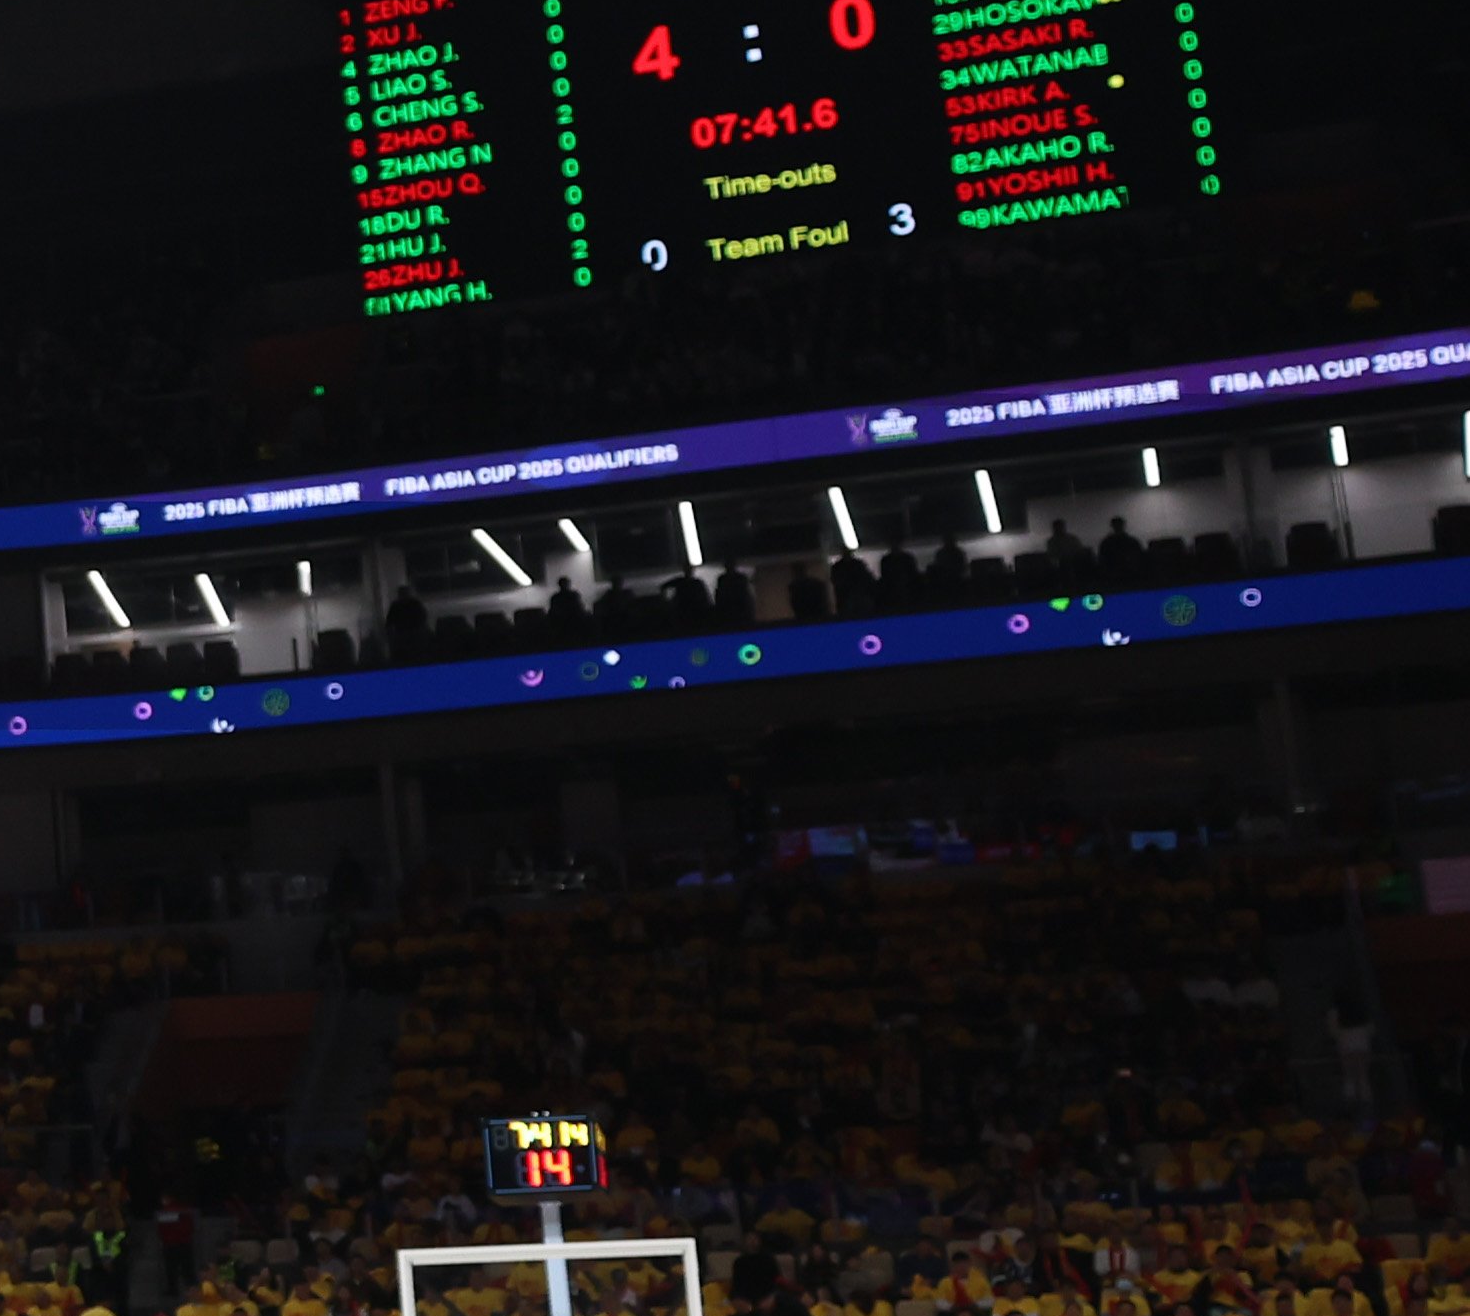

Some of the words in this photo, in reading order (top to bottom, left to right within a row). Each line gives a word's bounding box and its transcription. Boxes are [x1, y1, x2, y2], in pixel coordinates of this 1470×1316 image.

[340, 9, 352, 27] 1
[1067, 17, 1096, 39] R.
[340, 34, 356, 54] 2
[365, 24, 401, 48] XU
[405, 21, 423, 43] J.
[631, 24, 681, 81] 4
[340, 59, 357, 80] 4
[366, 43, 438, 76] ZHAO
[441, 41, 460, 64] J.
[343, 86, 361, 106] 5
[369, 72, 427, 102] LIAO
[429, 68, 453, 91] S.
[1044, 80, 1071, 102] A.
[345, 112, 363, 132] 6
[372, 94, 459, 127] CHENG
[461, 90, 485, 114] S.
[690, 97, 840, 150] 07:41.6
[1073, 103, 1099, 126] S.
[376, 123, 447, 155] ZHAO
[451, 120, 476, 142] R.
[555, 103, 574, 125] 2
[1087, 130, 1115, 155] R.
[350, 164, 369, 184] 9
[377, 146, 467, 180] ZHANG
[469, 142, 493, 166] N
[1084, 160, 1115, 183] H.
[457, 172, 486, 196] Q.
[701, 162, 838, 201] Time-outs
[425, 204, 450, 227] R.
[428, 232, 447, 254] J.
[705, 233, 786, 263] Team
[788, 219, 850, 251] Foul
[887, 201, 917, 236] 3
[571, 238, 589, 260] 2
[465, 279, 493, 302] H.
[1210, 369, 1264, 396] FIBA
[1266, 362, 1321, 389] ASIA
[1322, 355, 1371, 381] CUP
[1372, 347, 1429, 376] 2025
[945, 403, 995, 428] 2025
[997, 397, 1046, 422] FIBA
[385, 473, 431, 499] FIBA
[432, 467, 476, 492] ASIA
[477, 461, 517, 486] CUP
[518, 456, 564, 481] 2025
[565, 442, 680, 476] QUALIFIERS
[164, 499, 205, 523] 2025
[207, 494, 249, 518] FIBA
[525, 1148, 574, 1188] 14
